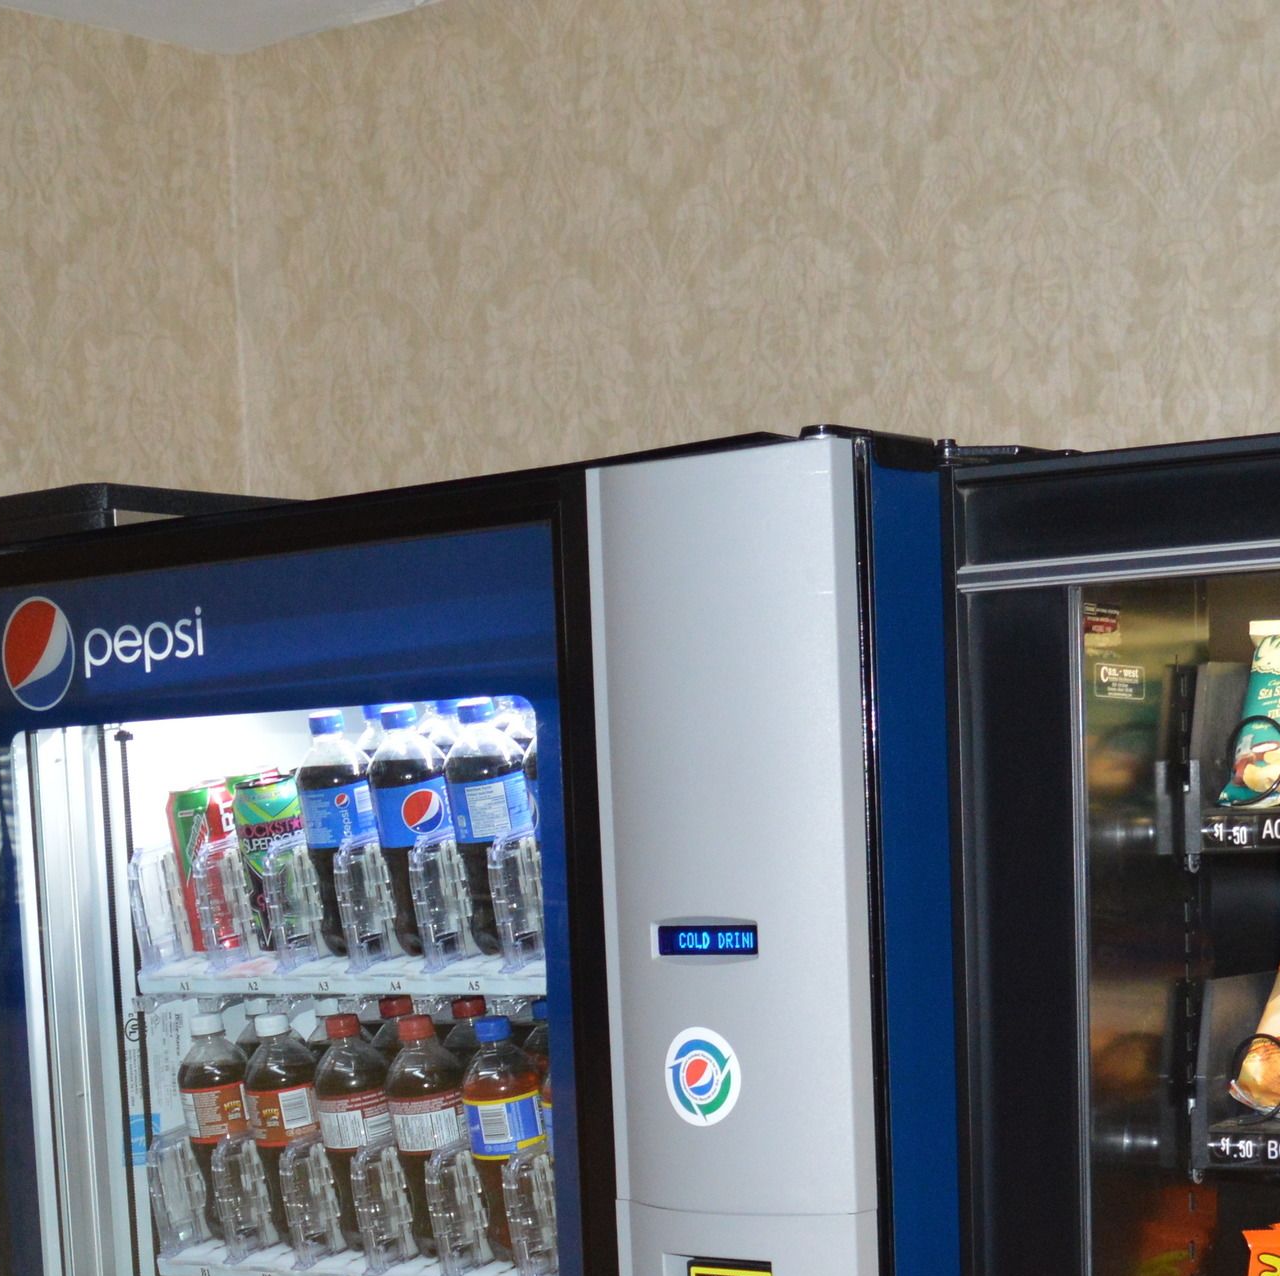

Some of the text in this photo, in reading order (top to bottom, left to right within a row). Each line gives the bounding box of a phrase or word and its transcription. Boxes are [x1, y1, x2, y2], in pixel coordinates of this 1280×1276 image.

[83, 605, 205, 679] pepsi
[1213, 823, 1248, 846] $1.50
[678, 931, 711, 950] COLD
[178, 981, 481, 992] A1 A2 A4 A5
[1220, 1137, 1254, 1160] $1.50
